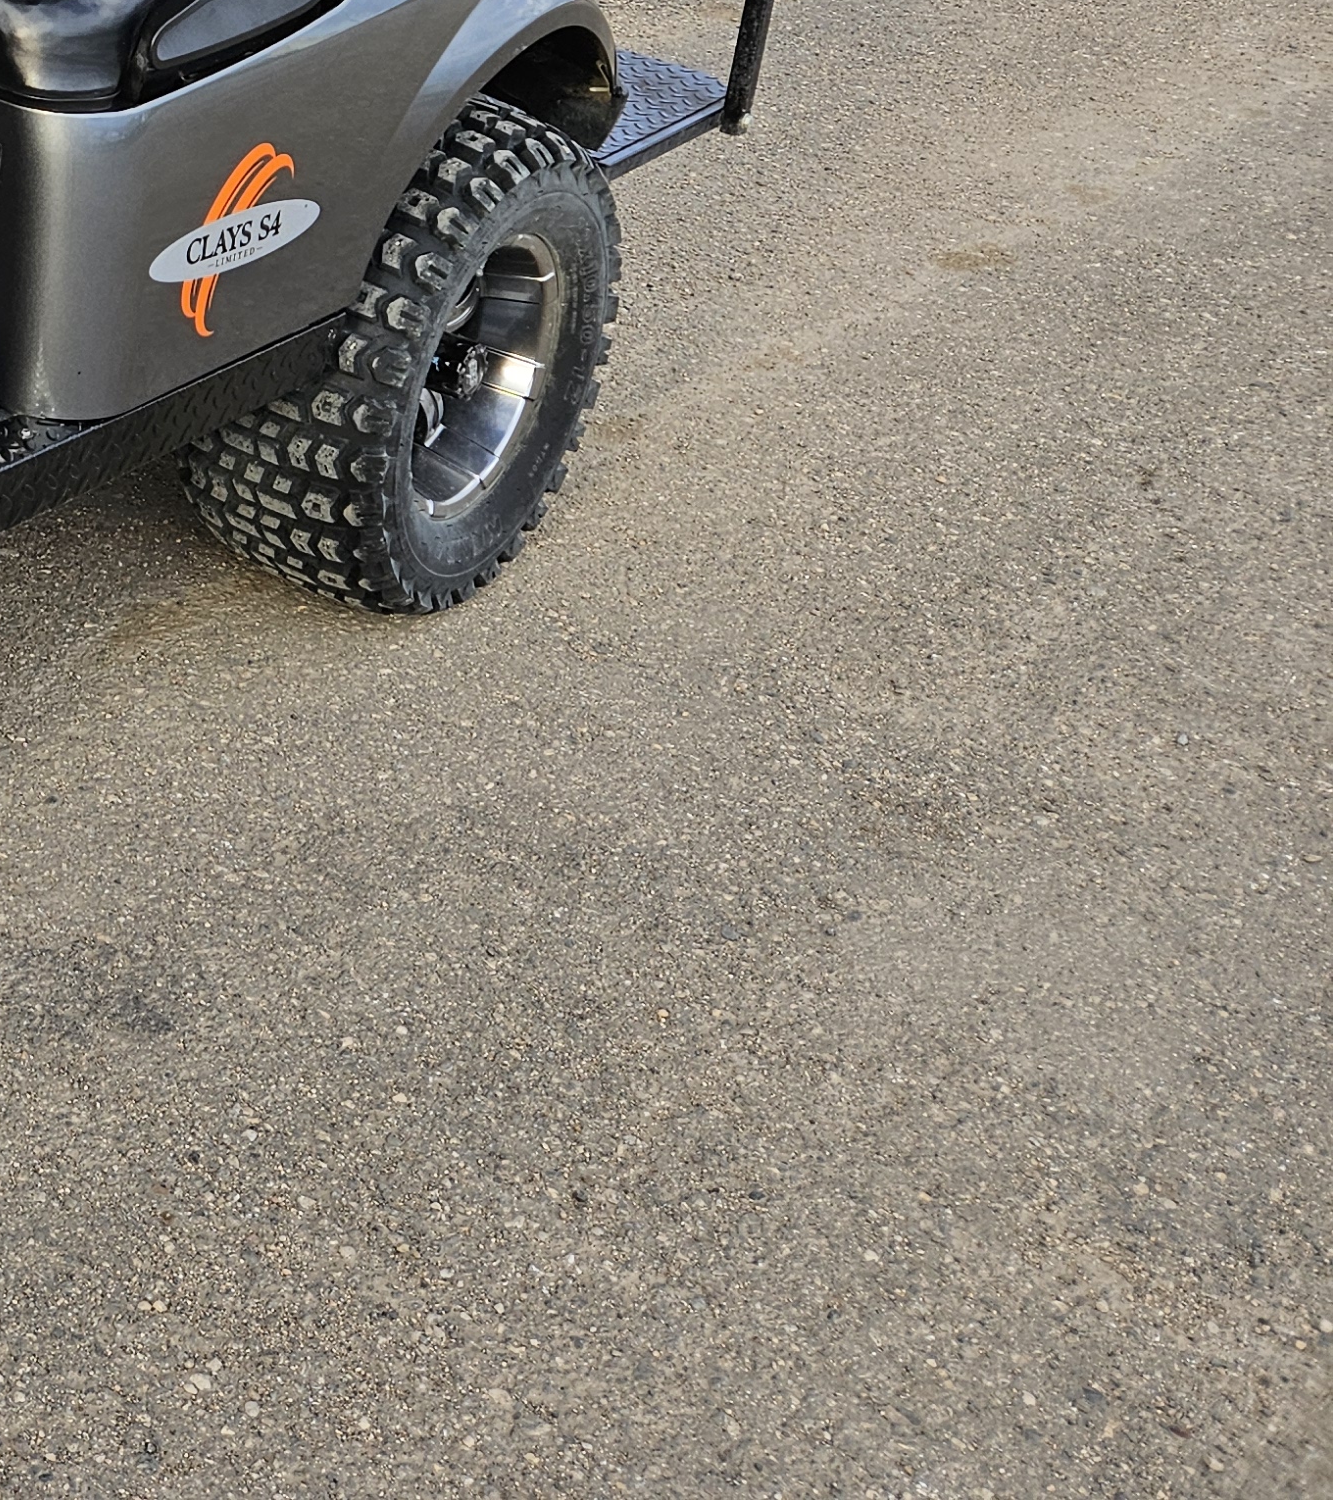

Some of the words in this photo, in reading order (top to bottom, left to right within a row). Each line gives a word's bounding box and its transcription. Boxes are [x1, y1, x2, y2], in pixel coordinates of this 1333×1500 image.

[186, 220, 254, 265] CLAYS
[257, 210, 282, 241] S4
[214, 246, 256, 268] LIMITED
